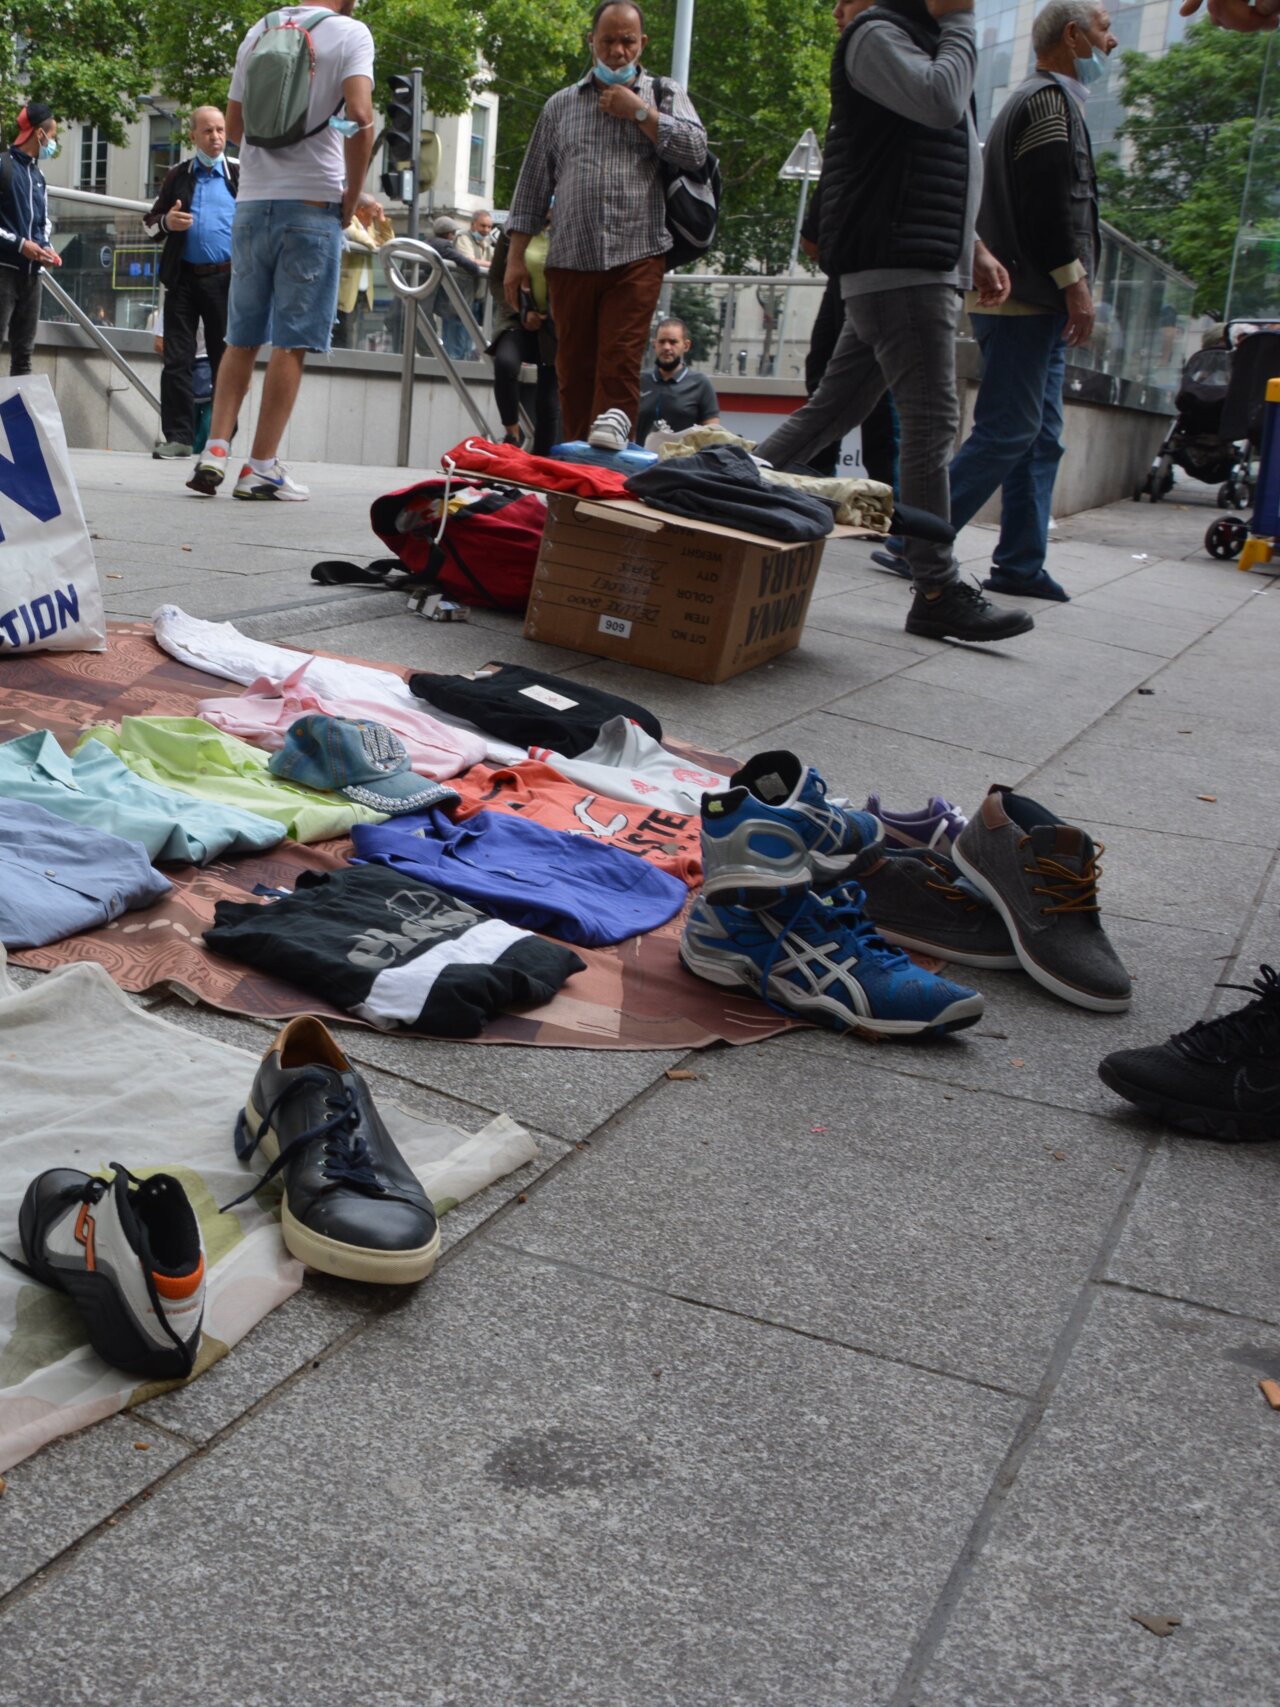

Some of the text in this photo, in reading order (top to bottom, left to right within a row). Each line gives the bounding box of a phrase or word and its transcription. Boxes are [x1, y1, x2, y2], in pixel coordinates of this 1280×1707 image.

[697, 570, 719, 583] QTY
[676, 588, 715, 605] COLOR
[684, 612, 710, 625] ITEM
